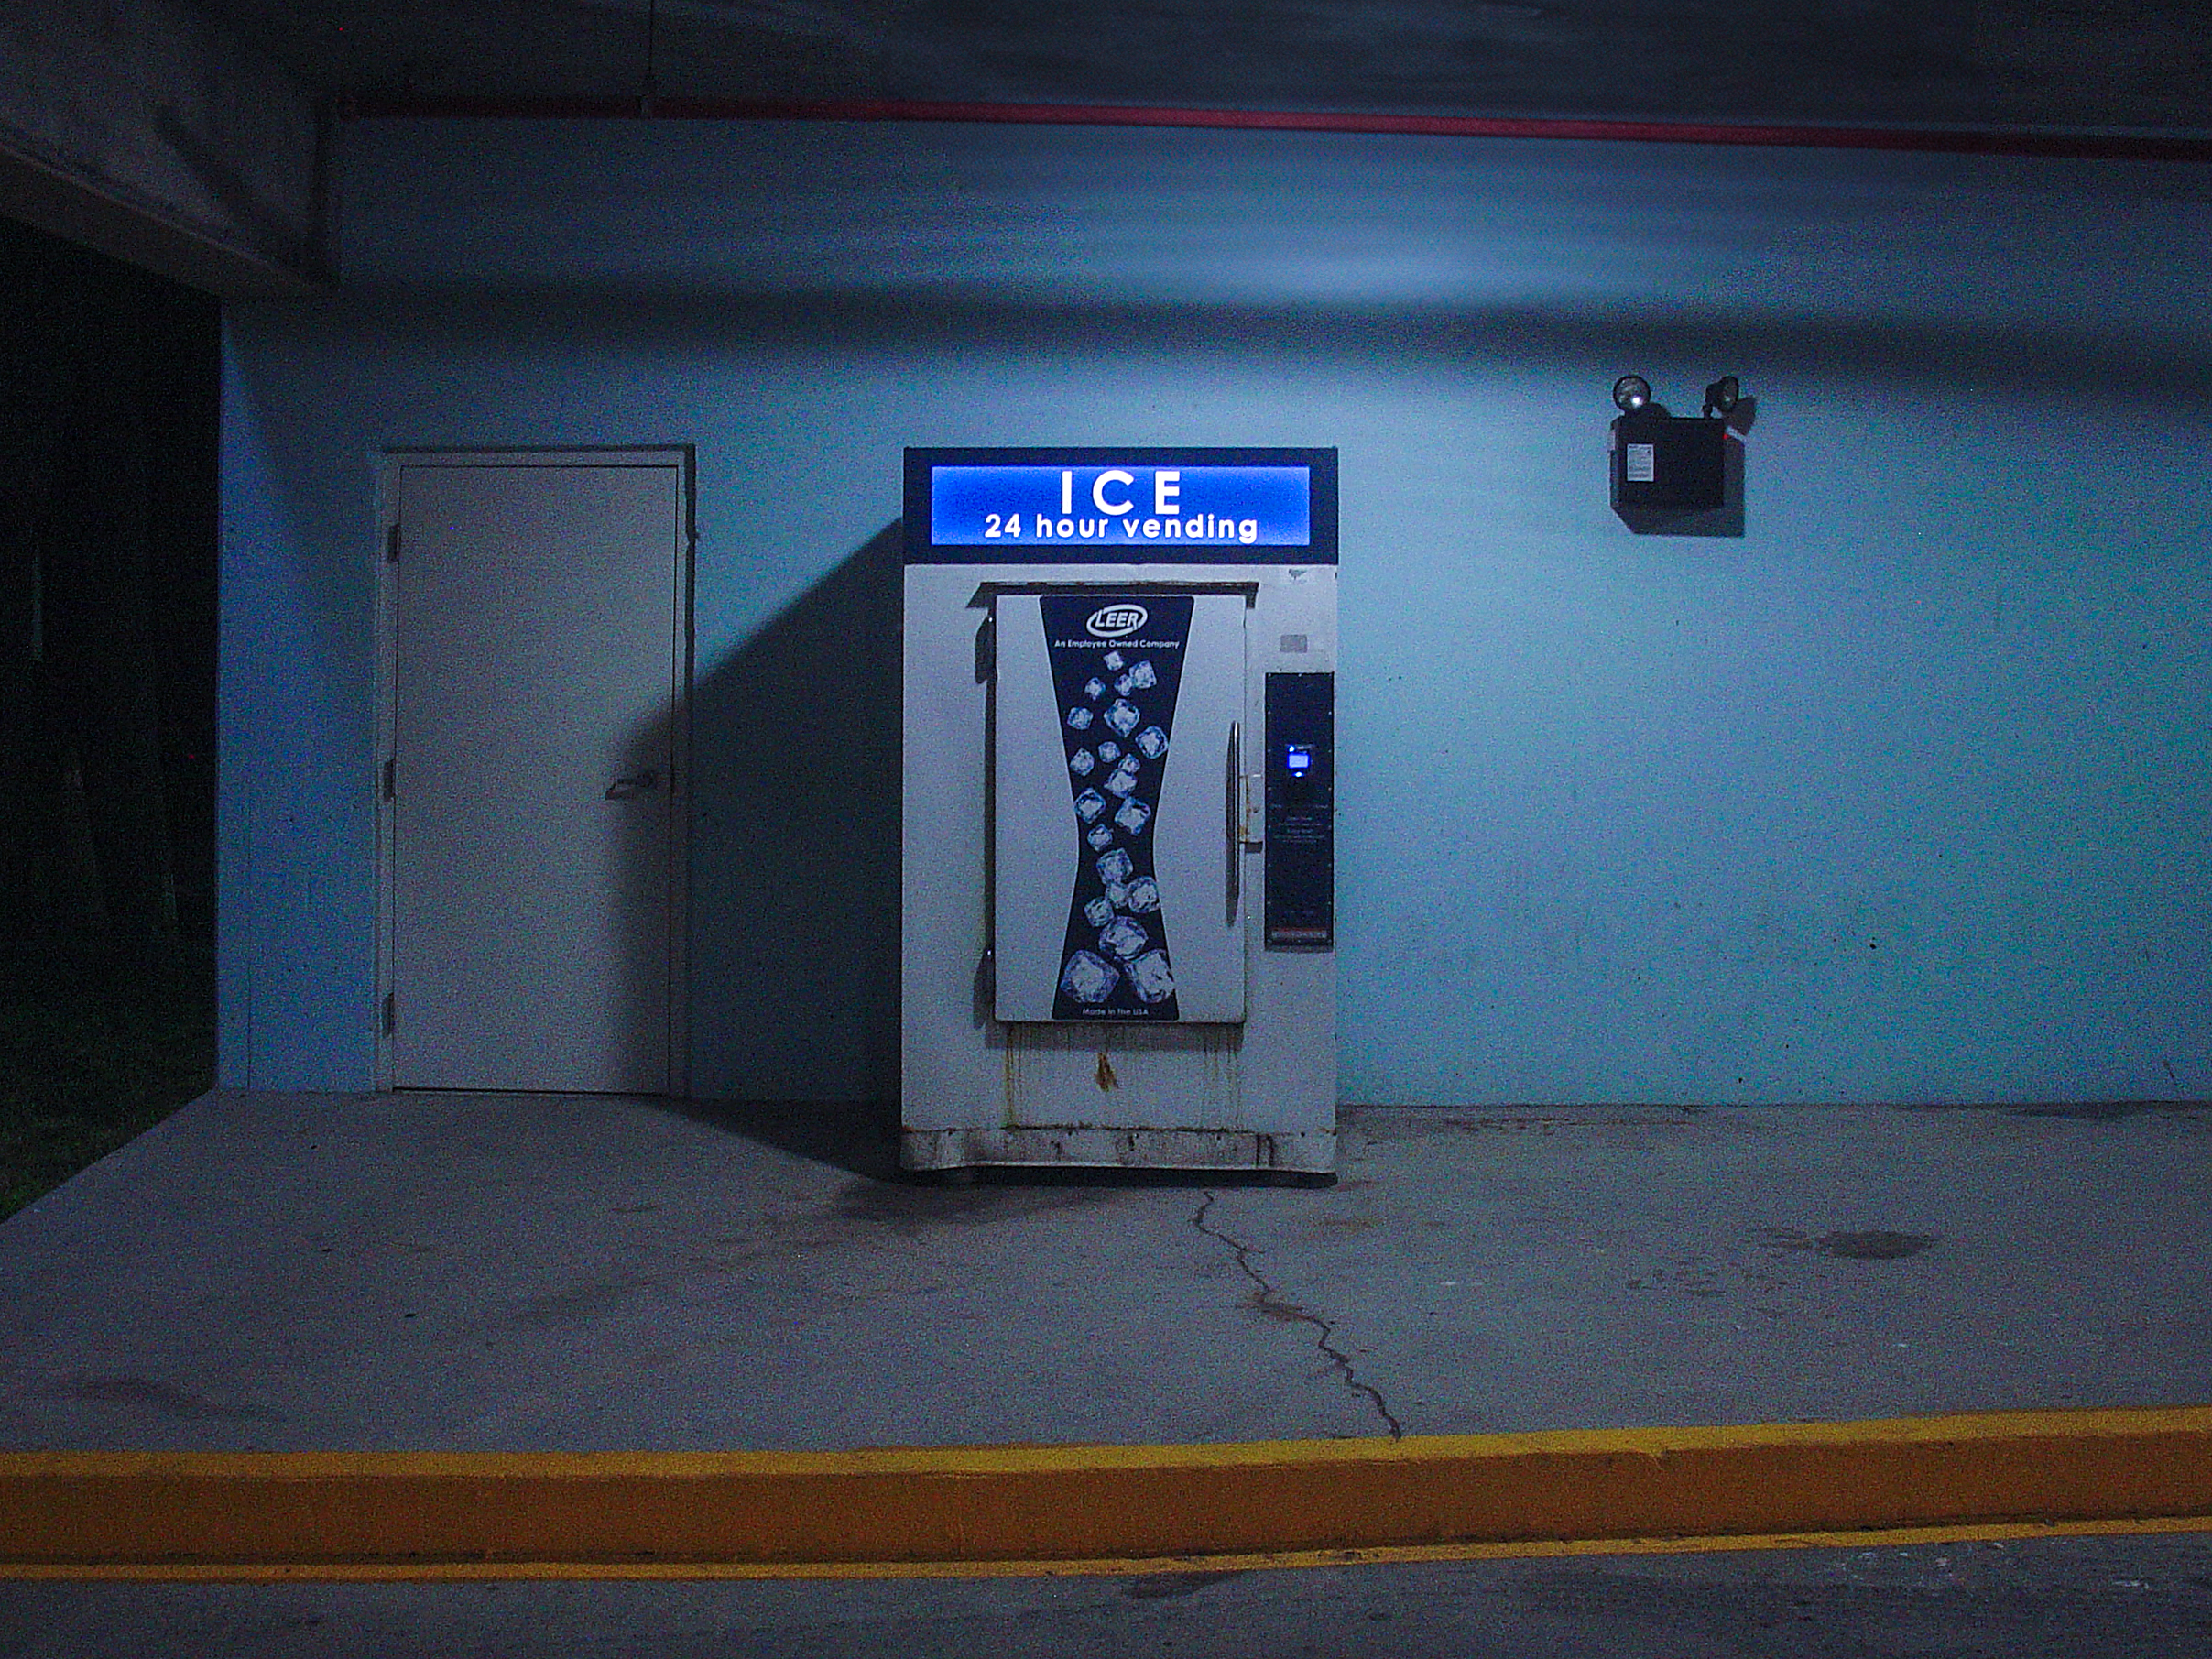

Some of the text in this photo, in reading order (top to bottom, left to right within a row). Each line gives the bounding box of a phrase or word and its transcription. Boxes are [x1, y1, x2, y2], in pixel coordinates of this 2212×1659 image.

[1062, 470, 1181, 516] ICE
[985, 514, 1258, 544] 24 hour vending
[1095, 610, 1139, 630] LEER
[1054, 639, 1180, 649] An Employee Owned Company
